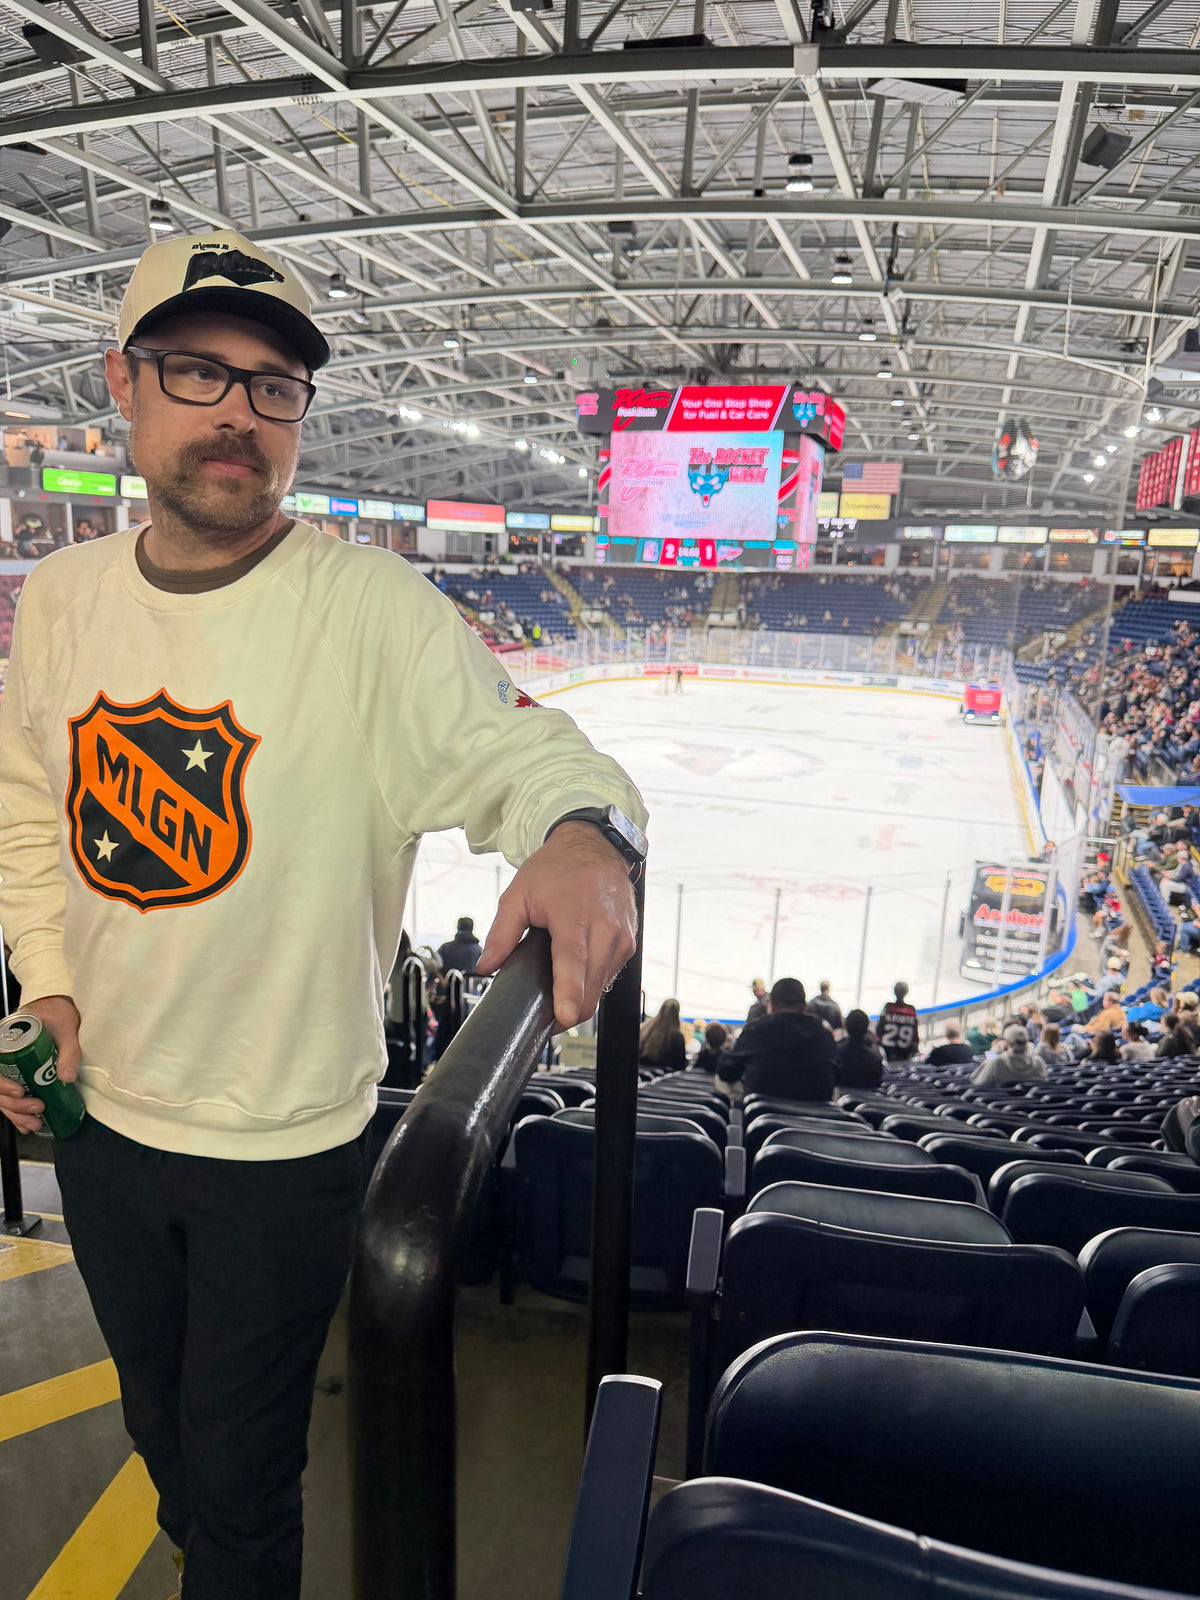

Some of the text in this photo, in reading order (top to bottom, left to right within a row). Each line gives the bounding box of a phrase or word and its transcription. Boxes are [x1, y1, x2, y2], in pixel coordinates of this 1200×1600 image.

[681, 398, 702, 409] Your
[703, 397, 723, 409] One
[724, 397, 747, 410] Stop
[748, 397, 773, 410] Shop
[683, 409, 697, 420] for
[698, 409, 719, 420] Fuel
[728, 409, 745, 420] Car
[746, 409, 769, 420] Care
[689, 447, 770, 465] The ROCKET
[665, 543, 675, 559] 2
[705, 544, 713, 560] 1
[96, 732, 213, 876] MLGN
[881, 1024, 914, 1048] 29
